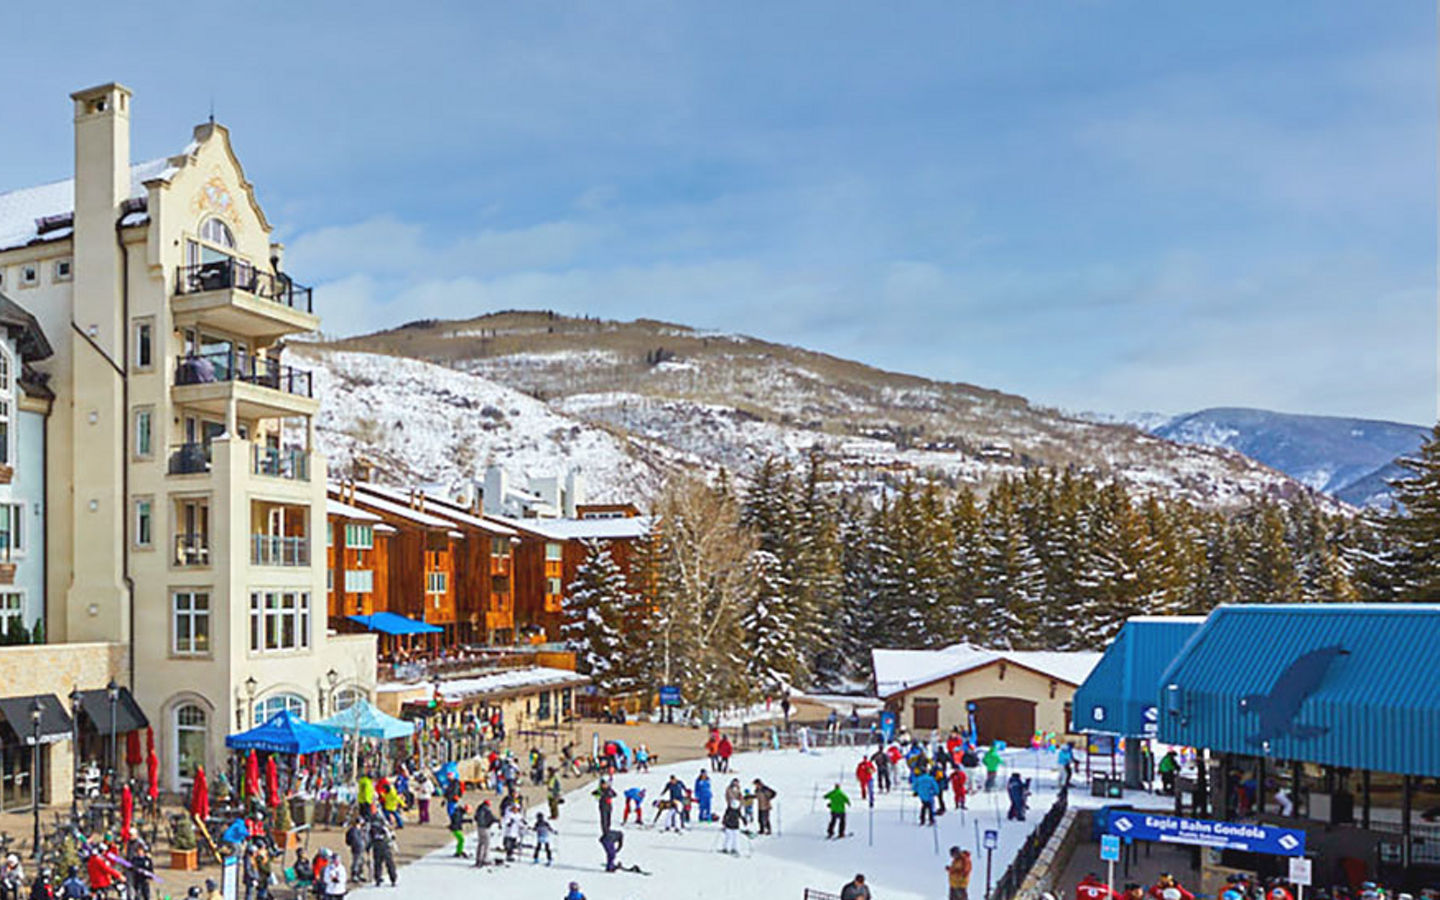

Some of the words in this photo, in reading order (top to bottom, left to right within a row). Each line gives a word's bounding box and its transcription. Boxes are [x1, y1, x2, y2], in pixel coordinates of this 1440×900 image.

[1145, 816, 1178, 830] Eagle
[1180, 818, 1211, 833] Bahn
[1213, 823, 1266, 839] Gondola
